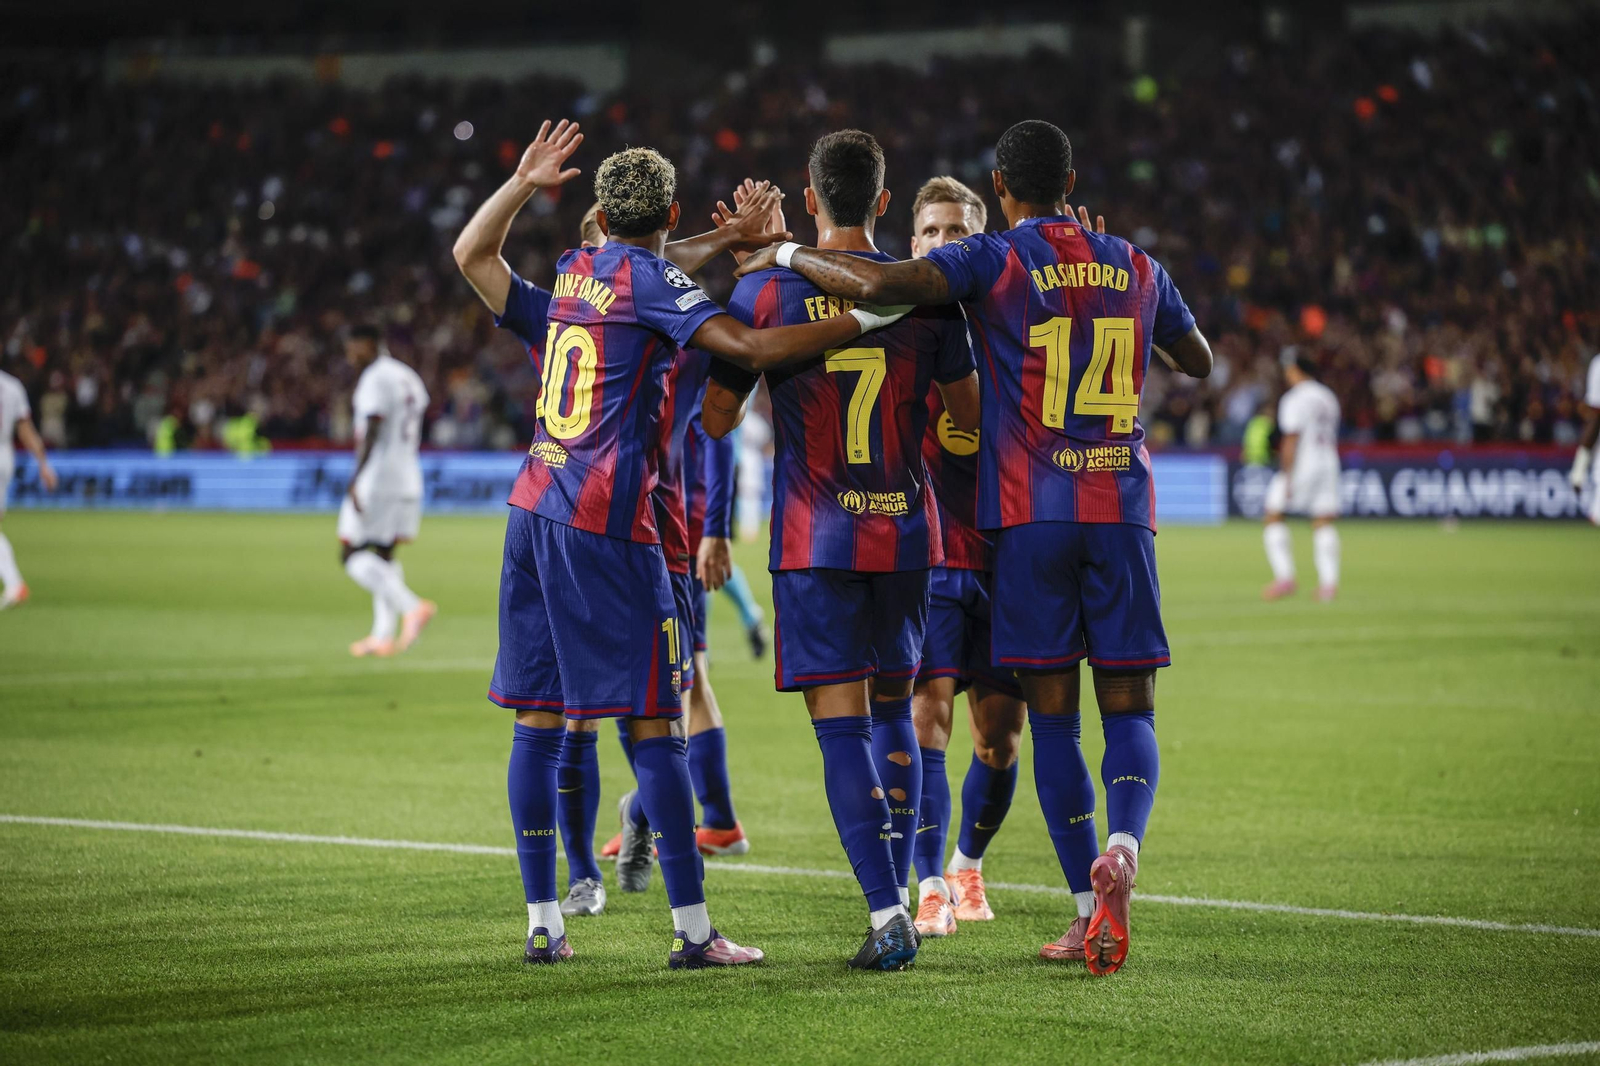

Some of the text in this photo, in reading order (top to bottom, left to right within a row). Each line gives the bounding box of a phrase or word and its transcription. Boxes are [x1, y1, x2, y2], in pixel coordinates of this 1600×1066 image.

[1031, 262, 1129, 293] RASHFORD
[536, 322, 598, 439] 10
[1029, 316, 1139, 433] 14
[824, 347, 887, 464] 7
[1086, 446, 1131, 458] UNHCR
[1086, 456, 1131, 468] ACNUR
[867, 491, 906, 502] UNHCR
[869, 501, 909, 512] ACNUR
[1390, 467, 1592, 516] CHAMPION
[661, 617, 680, 664] 1
[889, 807, 914, 816] ARÇA
